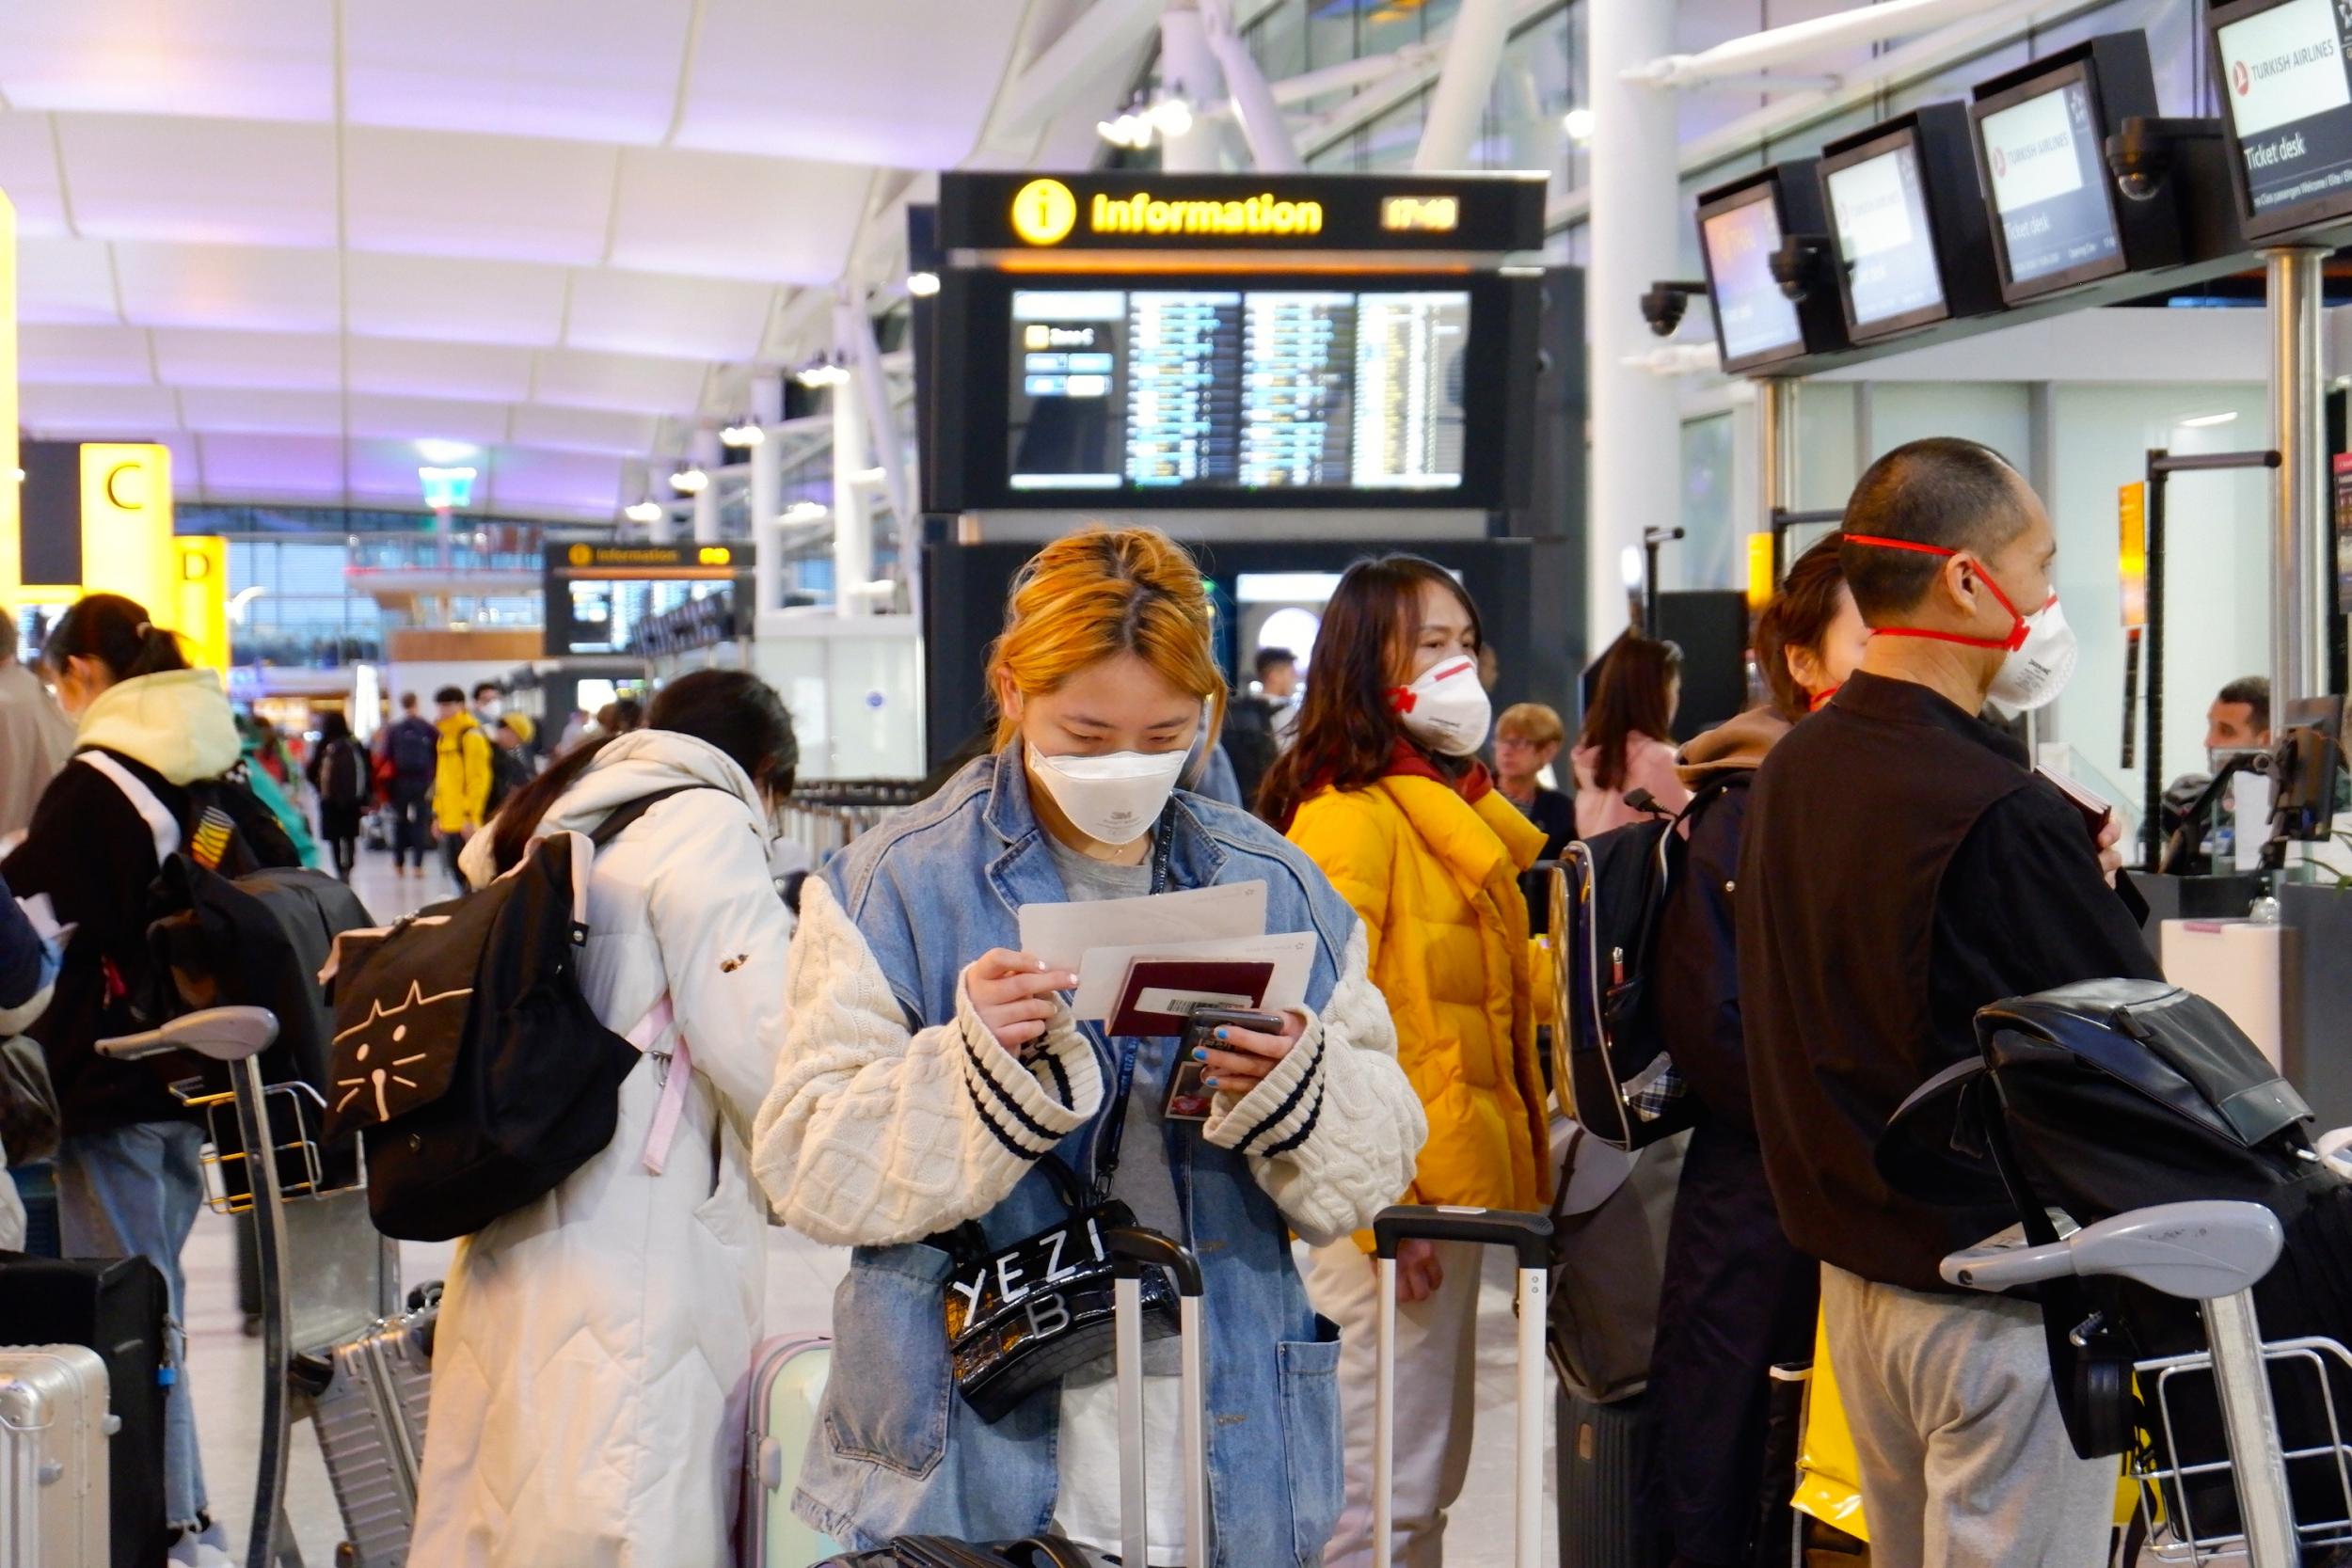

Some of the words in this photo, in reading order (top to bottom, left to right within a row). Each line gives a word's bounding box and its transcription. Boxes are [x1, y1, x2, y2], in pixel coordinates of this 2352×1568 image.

[2251, 55, 2290, 81] TURKISH
[2293, 39, 2334, 67] AIRLINES
[2008, 142, 2037, 166] TURKISH
[2039, 132, 2069, 154] AIRLINES
[2244, 143, 2279, 169] Ticket
[2280, 132, 2306, 161] desk
[1092, 193, 1322, 233] Information
[2003, 221, 2029, 241] Ticket
[2030, 211, 2050, 235] desk
[106, 464, 142, 510] C
[183, 550, 211, 580] D
[1110, 811, 1132, 820] 3M
[953, 1217, 1105, 1328] YEZI
